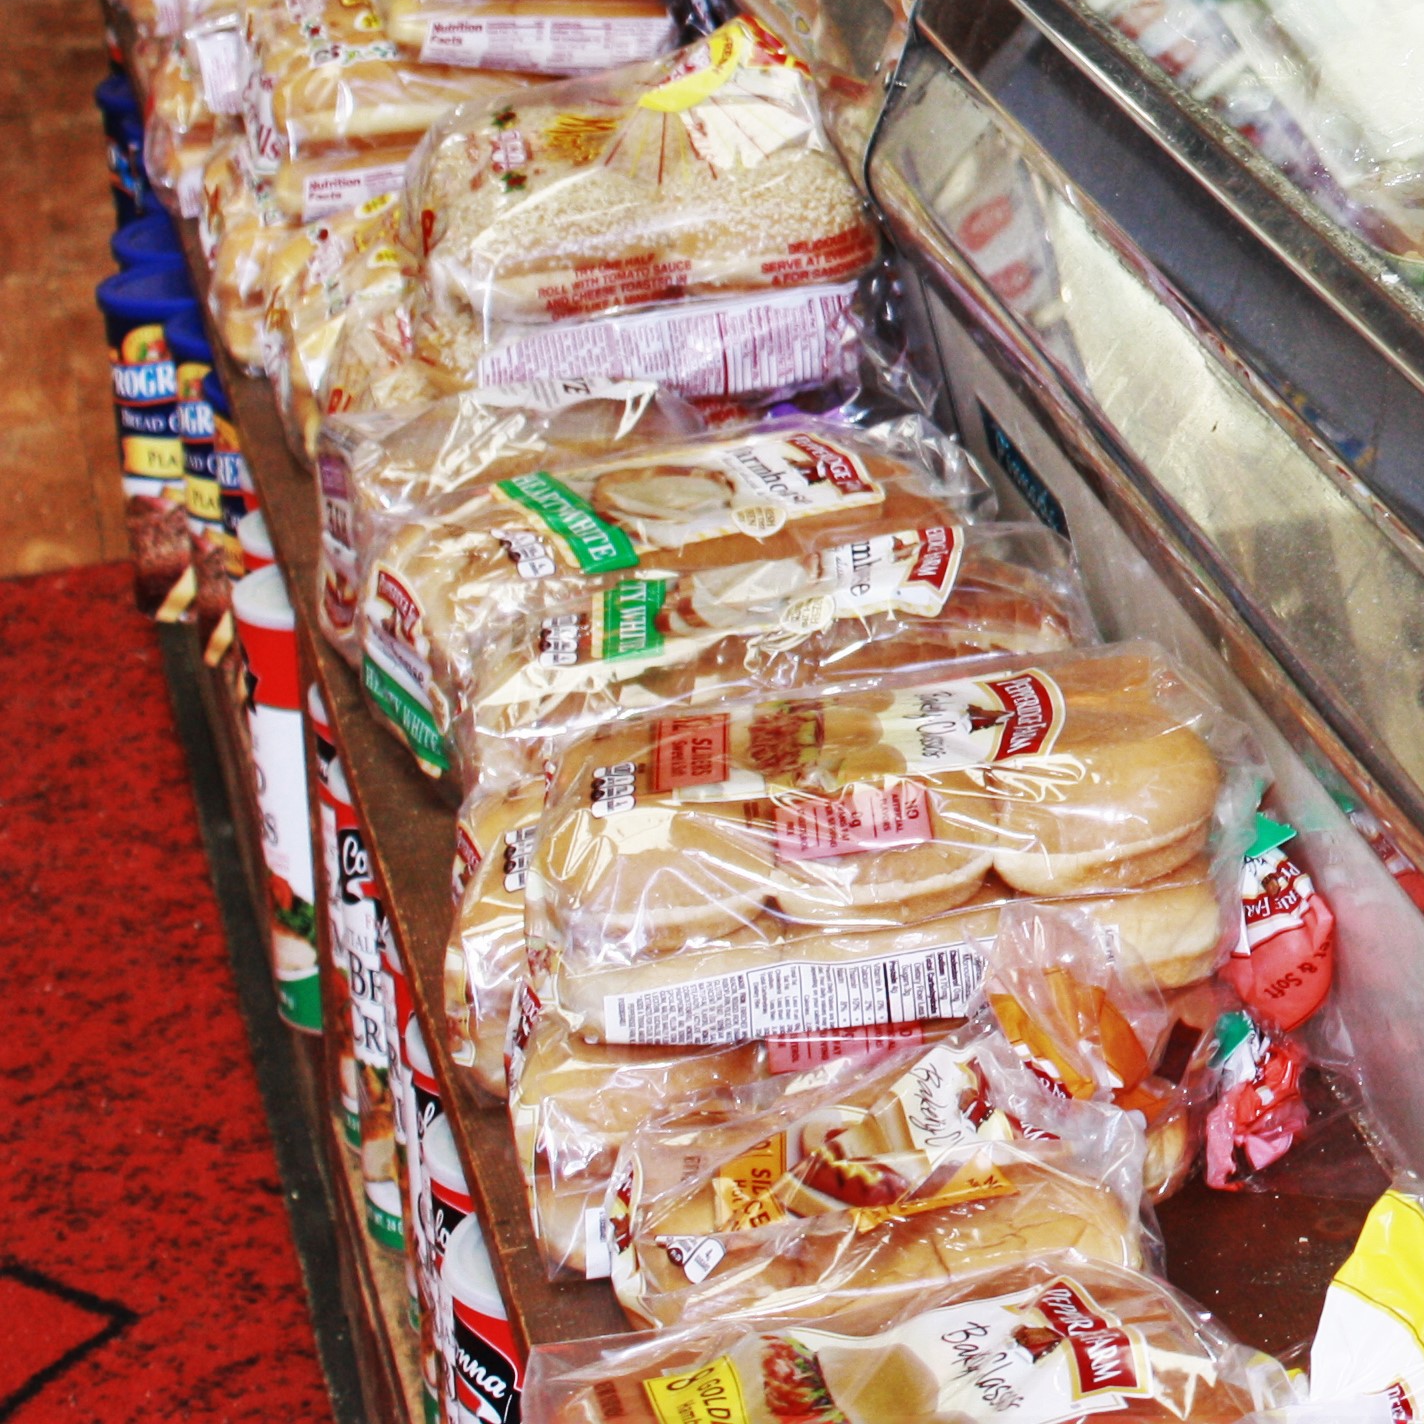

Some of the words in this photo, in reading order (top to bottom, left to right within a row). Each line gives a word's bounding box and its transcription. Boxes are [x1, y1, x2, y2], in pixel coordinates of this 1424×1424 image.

[432, 22, 483, 35] Nutrition
[308, 176, 362, 192] Nutrition
[651, 259, 692, 276] SAUCE
[557, 507, 618, 562] WHITE
[1010, 676, 1044, 725] PEPPERIDGE
[401, 704, 442, 757] WHITE
[1006, 721, 1044, 755] FARM
[1264, 972, 1303, 1000] Soft
